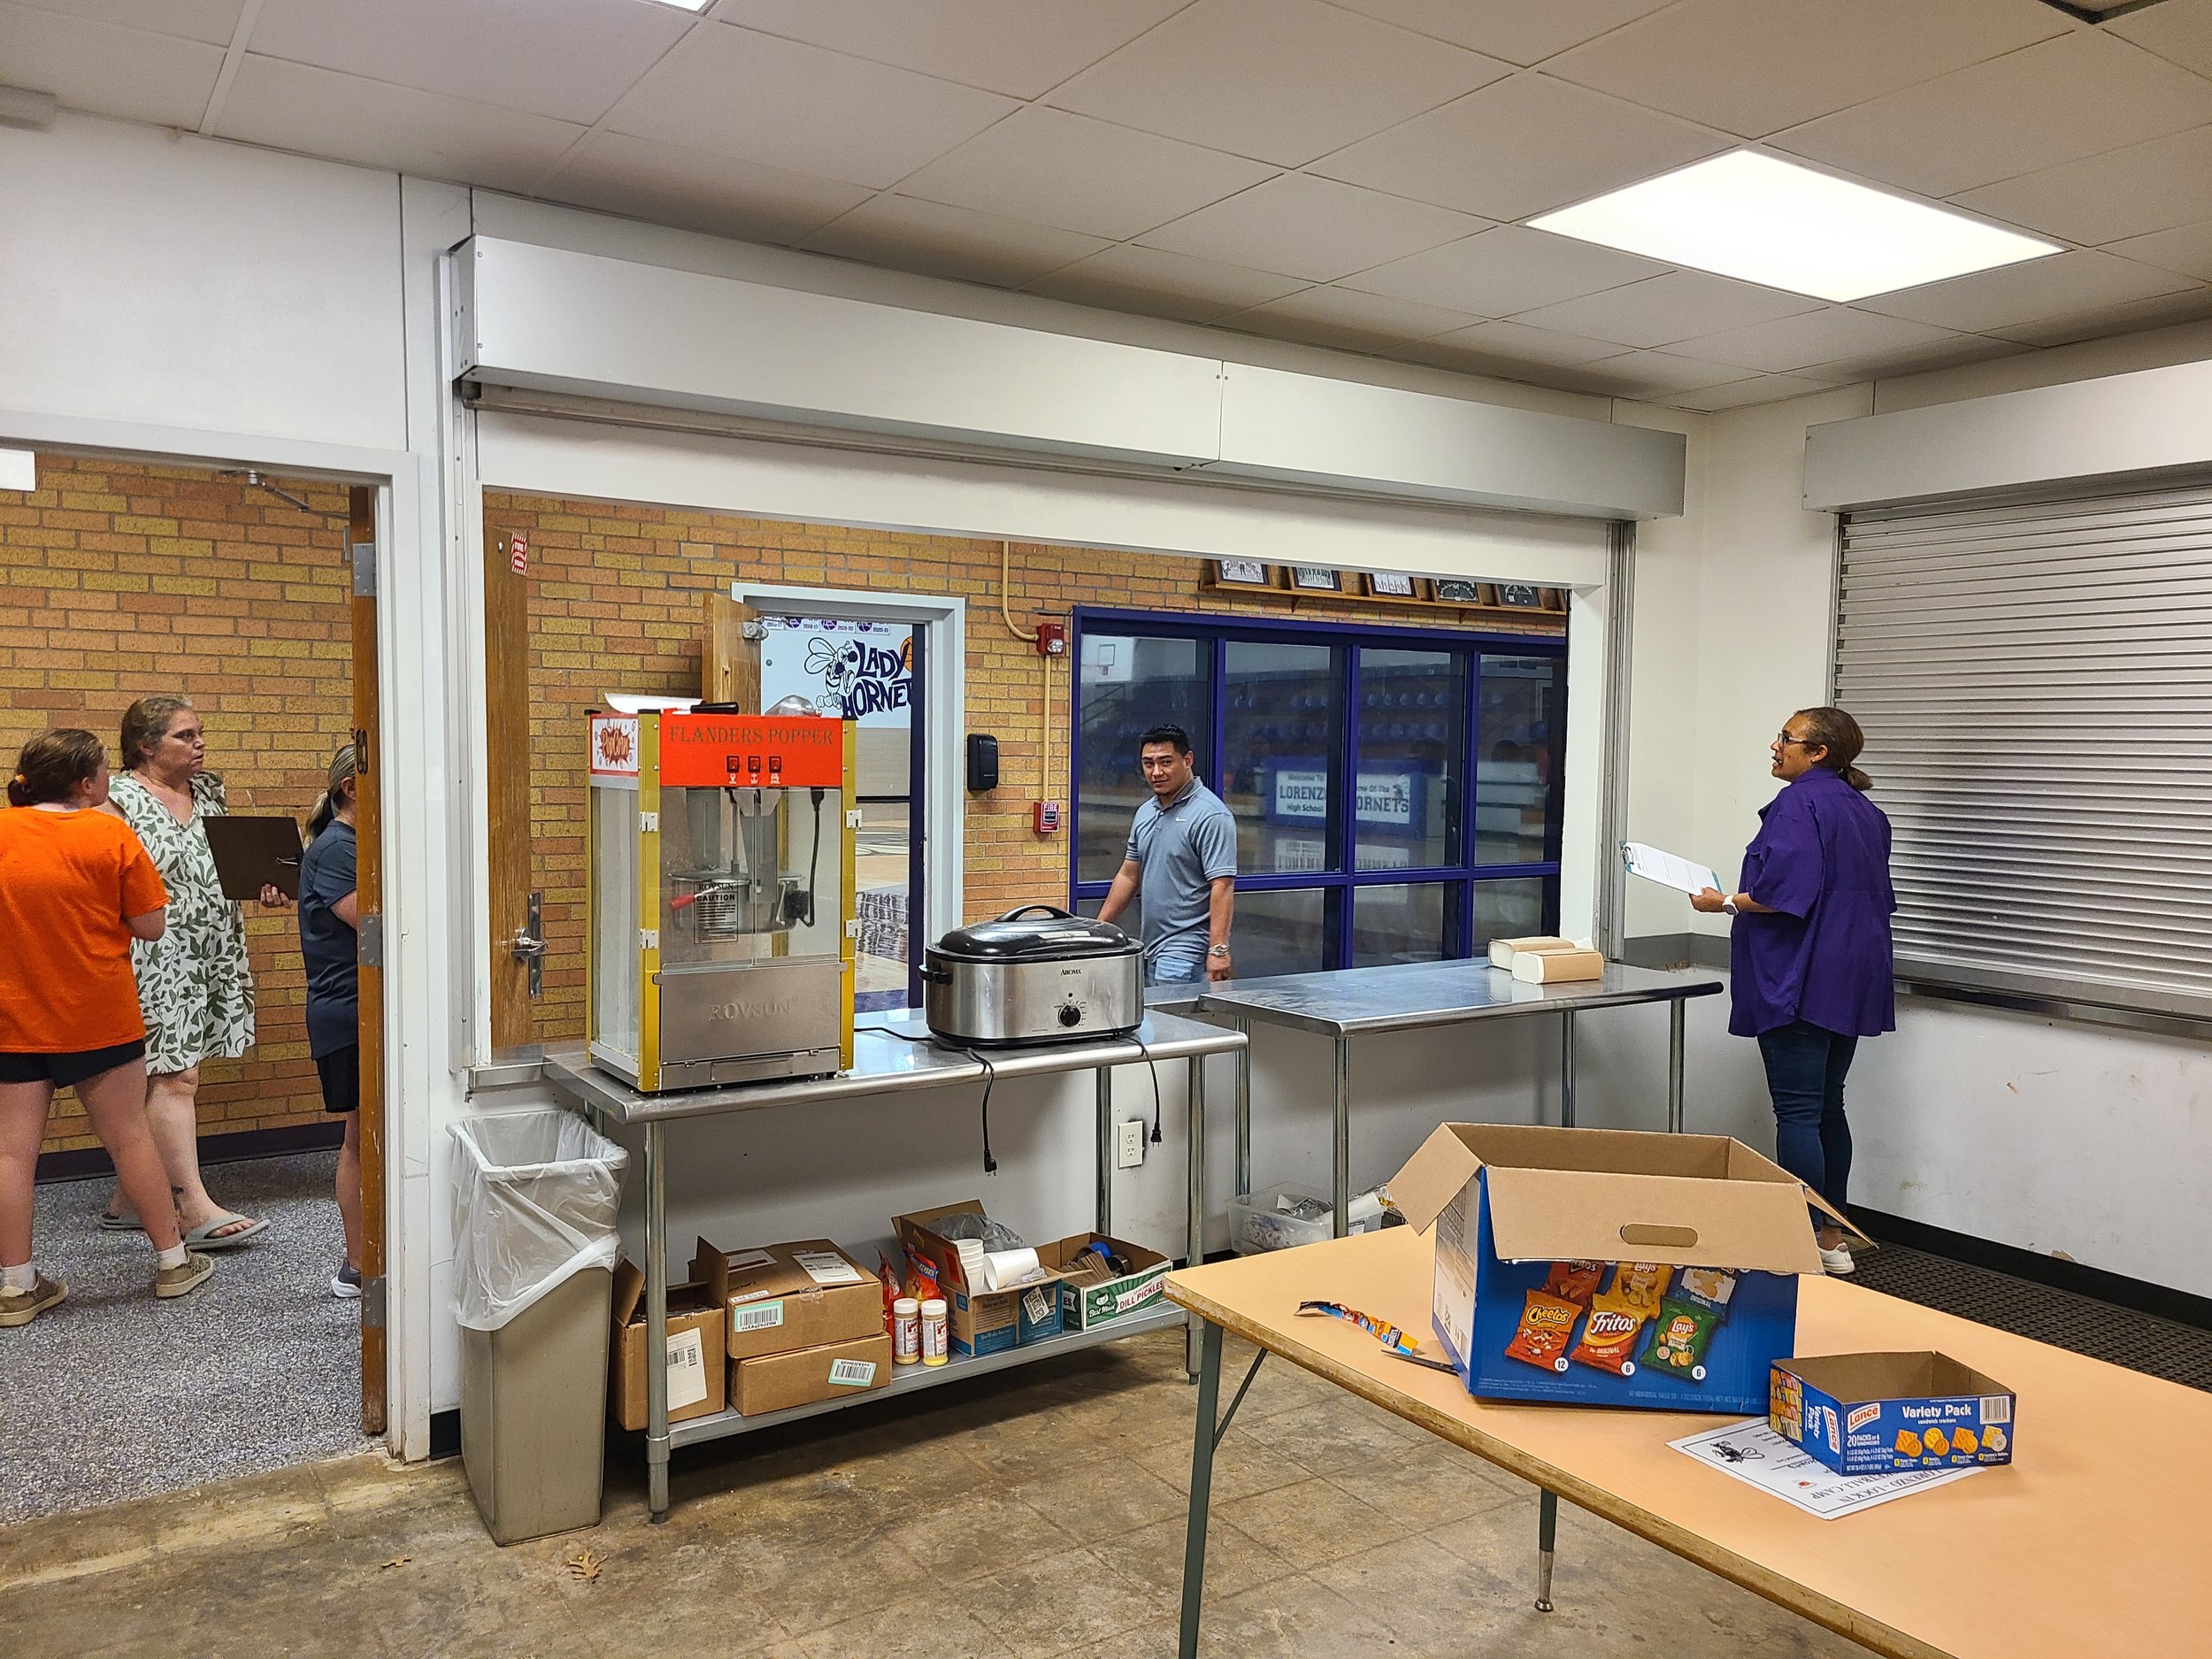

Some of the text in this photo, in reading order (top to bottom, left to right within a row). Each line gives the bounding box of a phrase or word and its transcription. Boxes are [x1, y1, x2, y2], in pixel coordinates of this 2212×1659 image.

[852, 639, 911, 681] LADY
[669, 726, 834, 745] FLANDERS POPPER
[1279, 785, 1325, 801] LORENZ
[1286, 803, 1324, 813] High School
[1357, 795, 1409, 813] ORNETS
[698, 883, 734, 892] ROVSUN
[696, 894, 735, 902] CAUTION
[1060, 968, 1082, 977] AROMA
[708, 1000, 791, 1022] ROVSUN
[1119, 1297, 1136, 1310] DILL
[1136, 1279, 1164, 1302] PICKLES
[1088, 1309, 1102, 1318] Best
[1527, 1306, 1570, 1323] Cheetos
[1590, 1311, 1636, 1334] Fritos
[1671, 1320, 1694, 1334] Lay's
[1556, 1360, 1565, 1370] 12
[1696, 1368, 1701, 1377] 6
[1848, 1405, 1879, 1427] Lance
[1901, 1403, 1972, 1419] Variety Pack
[1813, 1405, 1822, 1440] Variety
[1827, 1410, 1839, 1450] Lance
[1847, 1434, 1857, 1448] 20
[1810, 1486, 1845, 1500] CAMP
